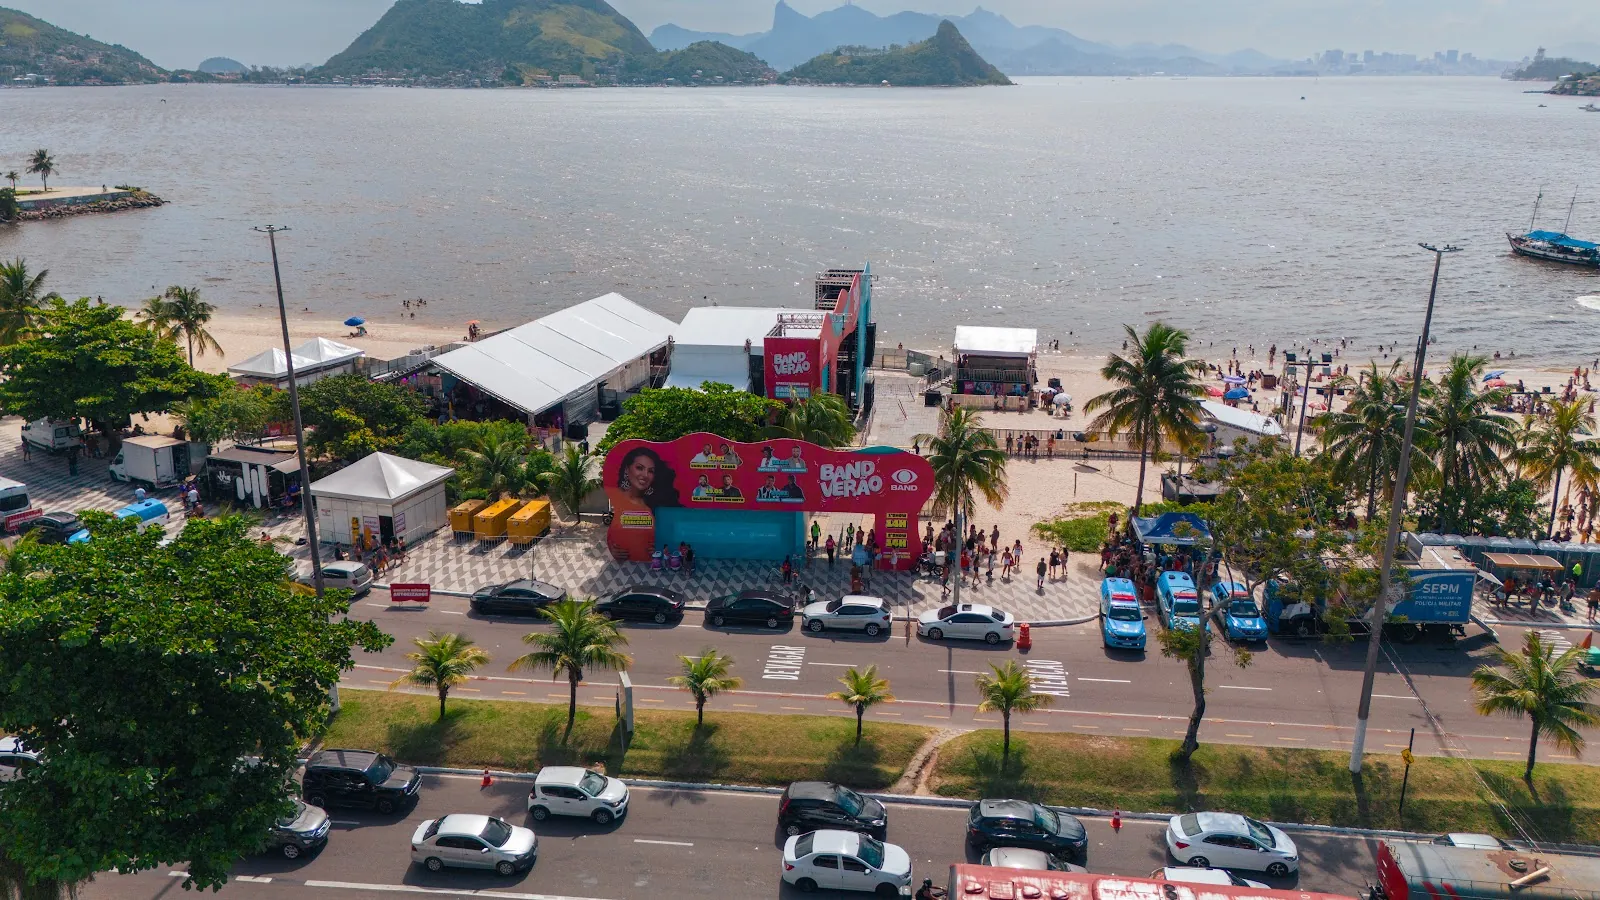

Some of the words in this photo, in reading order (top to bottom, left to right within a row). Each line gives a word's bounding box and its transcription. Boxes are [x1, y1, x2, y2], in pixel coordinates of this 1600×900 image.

[774, 352, 806, 364] BAND
[774, 361, 810, 374] VERÃO
[820, 460, 876, 481] BAND
[819, 475, 883, 497] VERÃO
[1422, 584, 1459, 593] SEPM
[762, 645, 806, 680] DEVAGAR
[1022, 659, 1070, 697] ATENÇÃO
